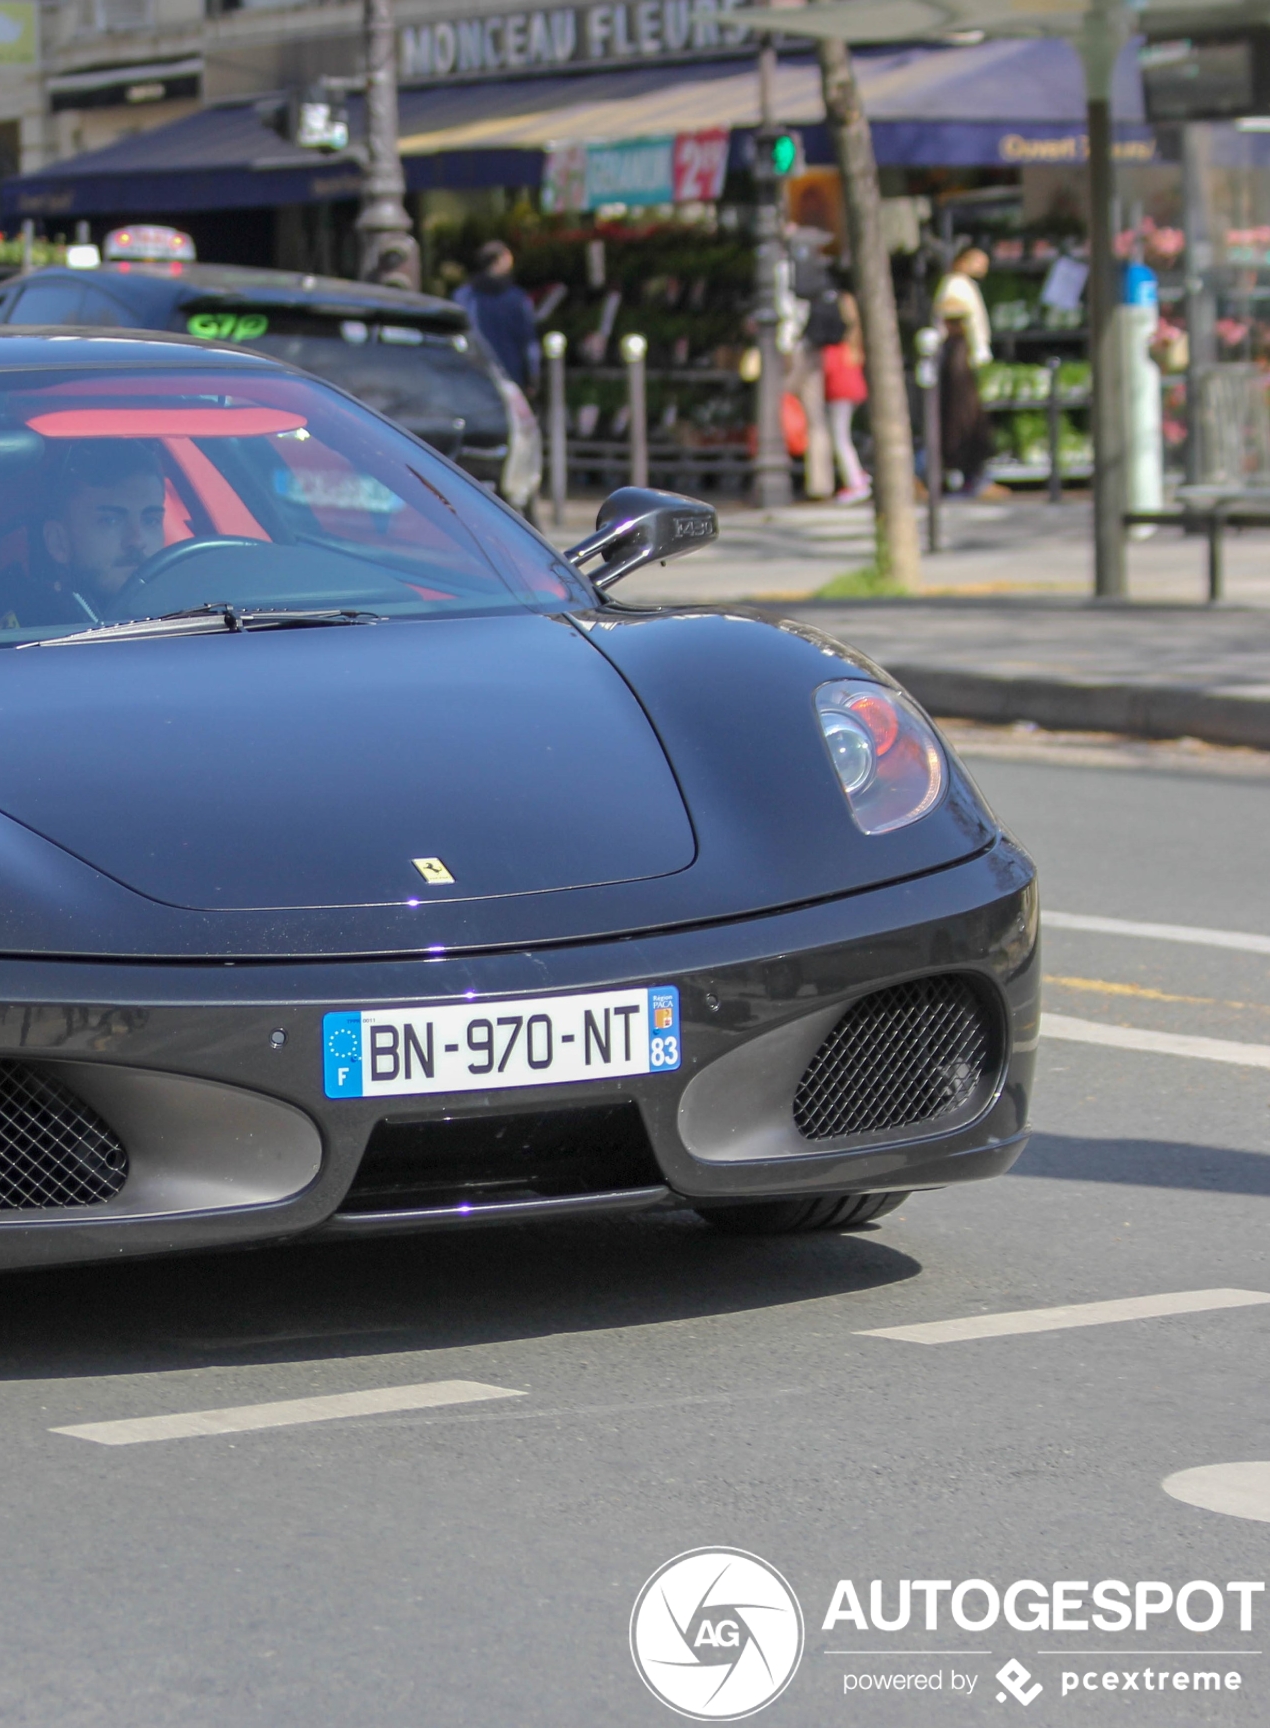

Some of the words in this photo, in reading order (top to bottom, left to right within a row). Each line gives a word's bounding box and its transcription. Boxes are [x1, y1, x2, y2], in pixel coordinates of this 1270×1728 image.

[401, 8, 577, 76] MONCEAU
[673, 517, 713, 538] F430
[653, 1001, 673, 1009] PACA
[370, 1005, 640, 1082] BN-970-NT
[651, 1035, 678, 1067] 83
[337, 1067, 349, 1086] F
